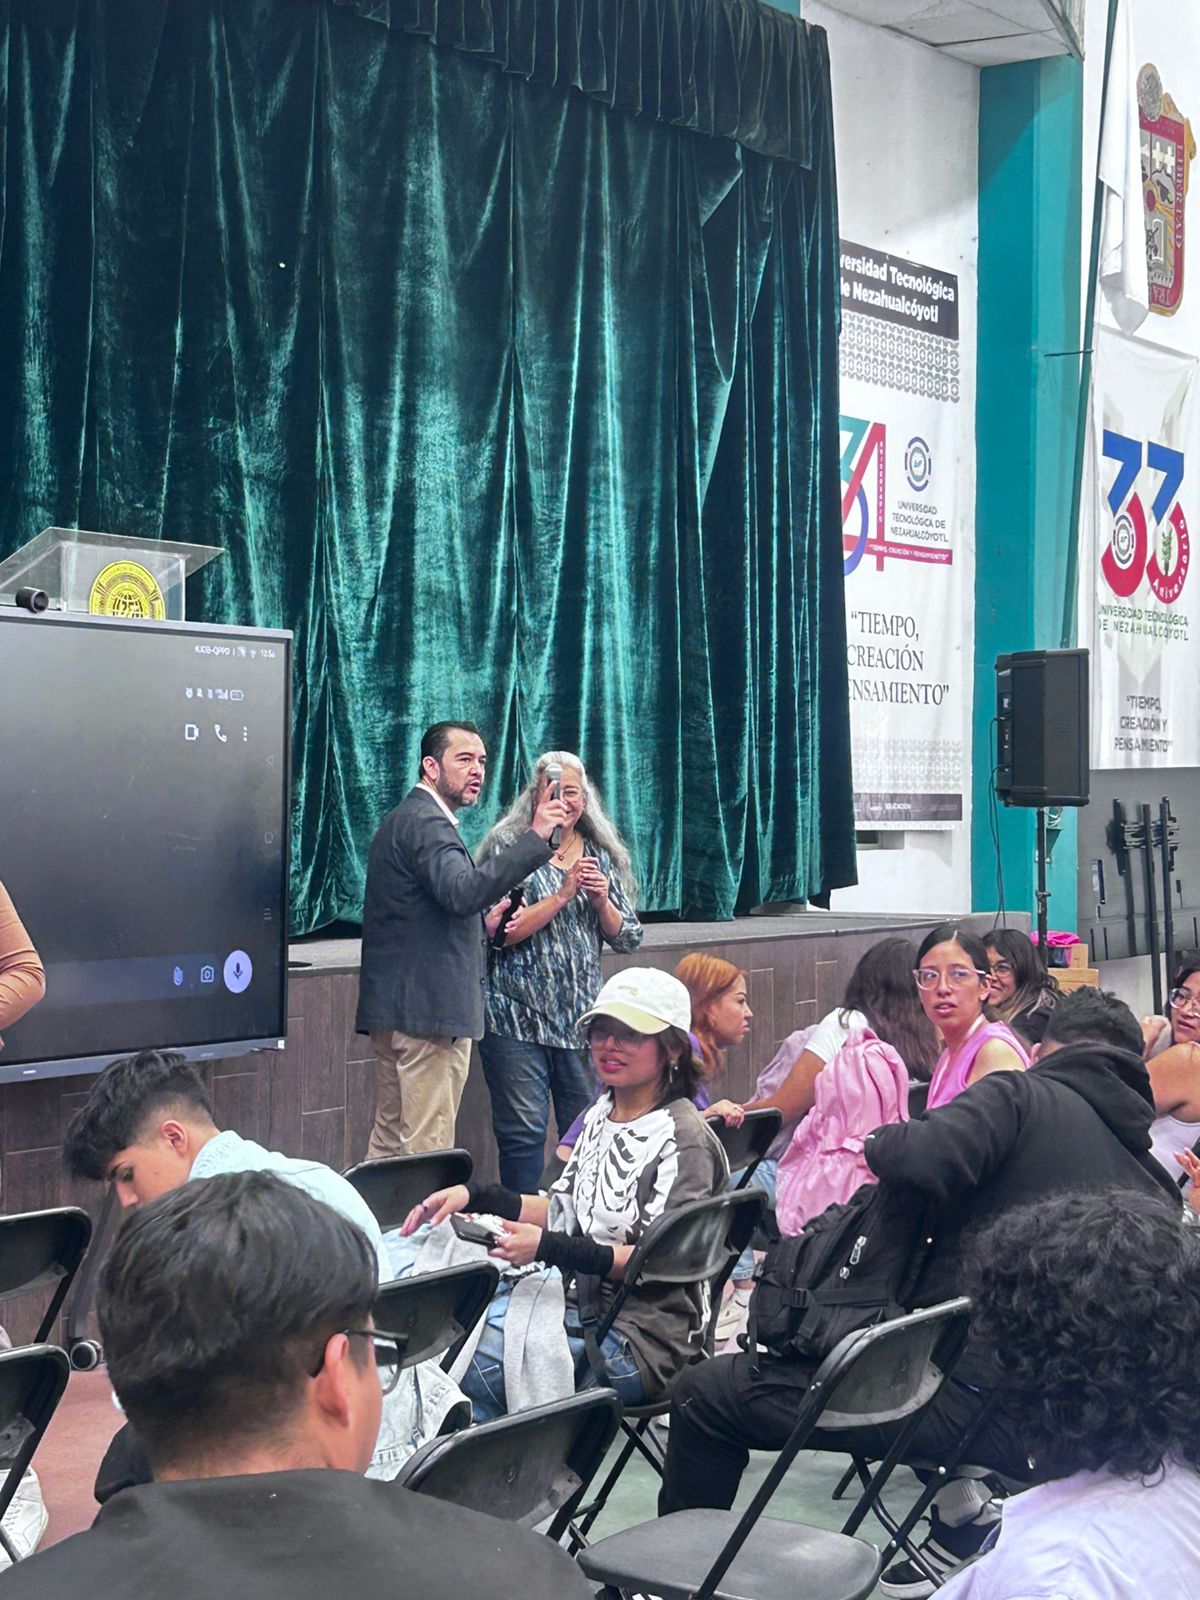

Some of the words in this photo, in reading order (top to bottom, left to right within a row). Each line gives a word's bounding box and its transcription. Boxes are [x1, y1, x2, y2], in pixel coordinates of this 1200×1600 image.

[889, 265, 955, 303] Tecnológica
[852, 281, 939, 324] Nezahualcóyotl
[897, 500, 938, 515] UNIVERSIDAD
[935, 519, 946, 529] DE
[847, 643, 924, 671] CREACIÓN
[1161, 718, 1168, 733] Y
